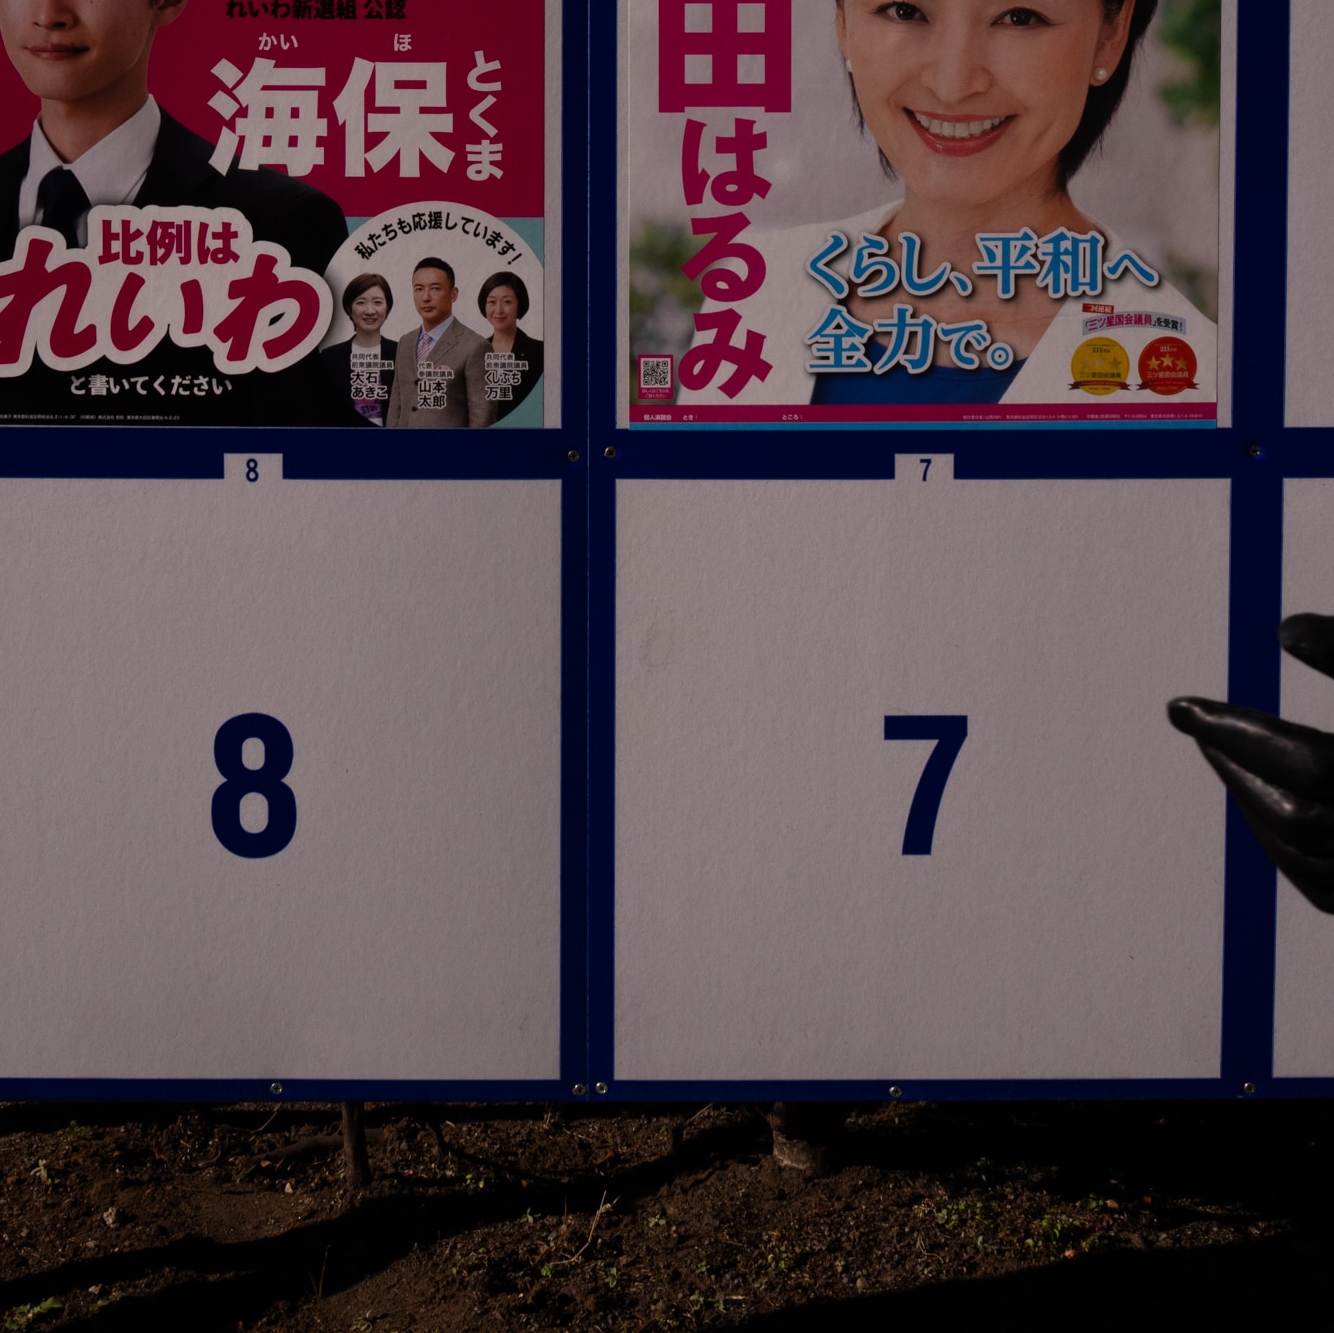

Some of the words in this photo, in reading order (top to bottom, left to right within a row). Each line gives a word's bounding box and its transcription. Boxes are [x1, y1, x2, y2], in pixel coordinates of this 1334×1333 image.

[258, 32, 299, 51] かい
[393, 33, 412, 52] ほ
[206, 55, 457, 180] 海保
[465, 50, 505, 182] とくま
[97, 218, 240, 267] 比例は
[69, 375, 234, 398] と書いてください
[351, 370, 378, 384] 大石
[418, 379, 447, 393] 山本
[351, 385, 389, 399] あきこ
[418, 394, 447, 408] 太郎
[485, 385, 513, 400] 万里
[245, 459, 259, 482] 8
[919, 458, 932, 482] 7
[210, 712, 298, 860] 8
[883, 715, 969, 857] 7
